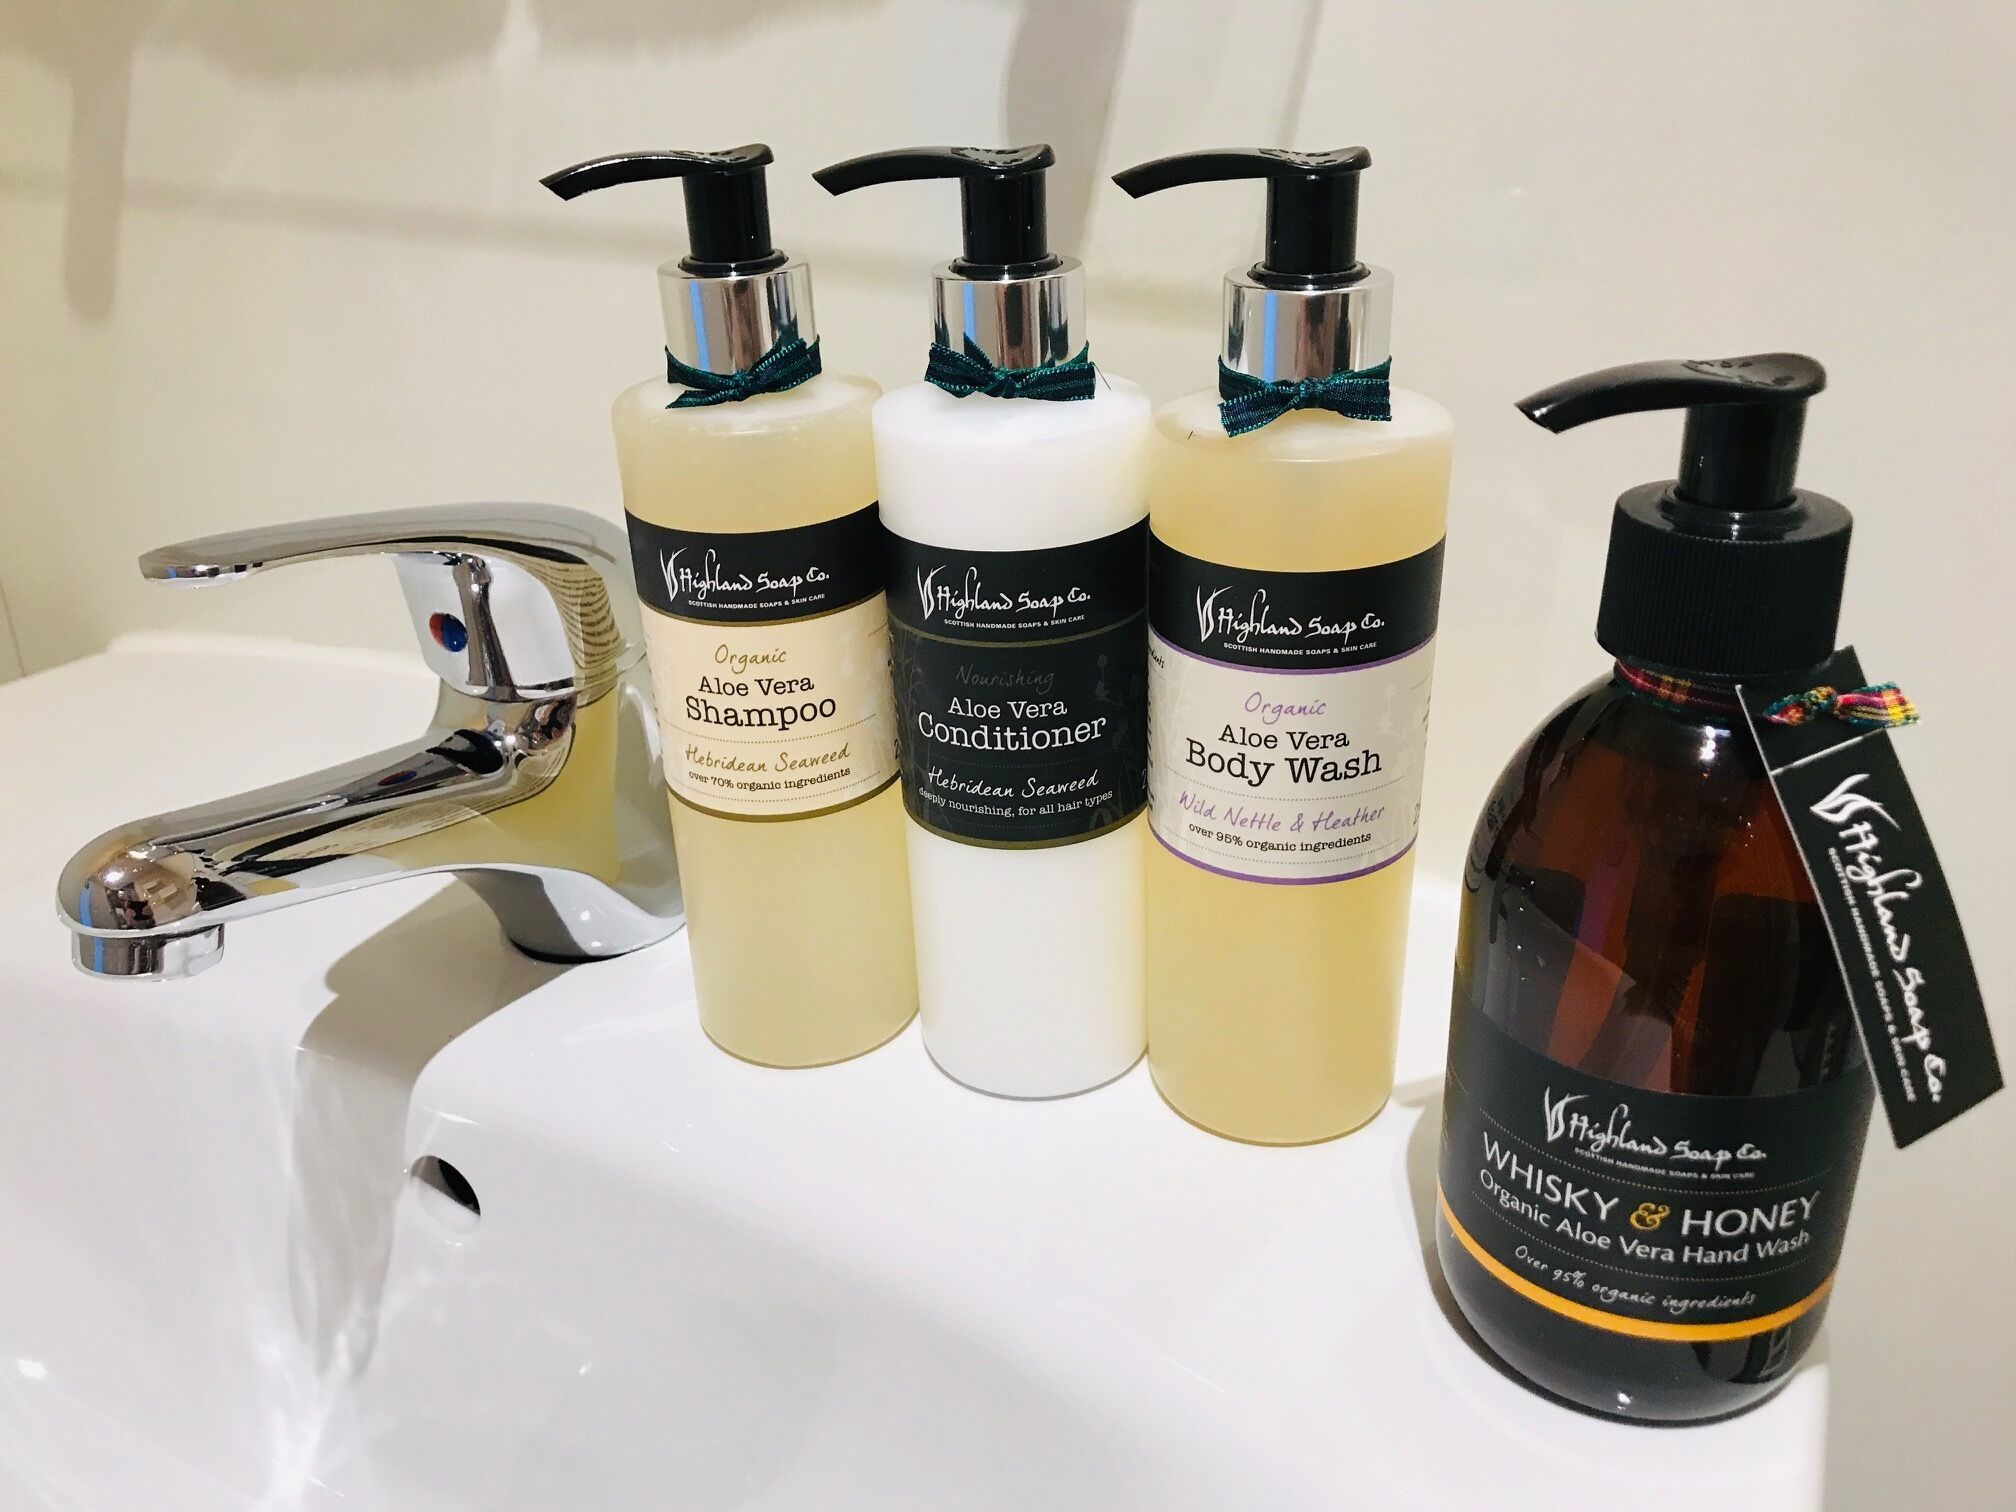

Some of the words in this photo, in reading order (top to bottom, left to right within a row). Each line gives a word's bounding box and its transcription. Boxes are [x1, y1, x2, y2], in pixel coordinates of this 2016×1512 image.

[679, 548, 753, 600] Highland
[755, 571, 804, 597] Soap
[806, 566, 830, 583] Co.
[688, 600, 718, 609] SCOTTISH
[759, 601, 783, 609] SOAPS
[791, 597, 807, 605] SKIN
[808, 593, 826, 602] CARE
[938, 566, 1013, 619] Highland
[1016, 591, 1064, 618] Soap
[1068, 586, 1090, 602] Co.
[944, 618, 974, 628] SCOTTISH
[1050, 618, 1067, 626] SKIN
[1068, 614, 1085, 624] CARE
[1218, 588, 1302, 642] Highland
[1305, 617, 1357, 644] Soap
[1361, 613, 1385, 629] Co.
[714, 644, 786, 674] Organic
[1223, 641, 1258, 653] SCOTTISH
[1260, 647, 1303, 656] HANDMADE
[1341, 645, 1358, 653] SKIN
[1360, 641, 1377, 650] CARE
[699, 676, 748, 696] Aloe
[755, 677, 814, 696] Vera
[956, 664, 1054, 694] Nourishing
[686, 695, 836, 730] Shampoo
[948, 697, 1000, 719] Aloe
[1006, 700, 1068, 719] Vera
[1244, 691, 1326, 725] Organic
[918, 712, 1106, 751] Conditioner
[1218, 724, 1278, 750] Aloe
[1286, 729, 1350, 751] Vera
[685, 744, 767, 772] Hebridean
[775, 742, 850, 772] Seaweed
[1186, 737, 1275, 787] Body
[1284, 750, 1382, 784] Wash
[689, 771, 709, 785] over
[711, 775, 734, 789] 70%
[737, 779, 781, 791] organic
[784, 767, 850, 789] ingredients
[928, 766, 1014, 797] Hebridean
[1022, 769, 1099, 798] Seaweed
[918, 787, 946, 807] deeply
[949, 800, 1015, 818] nourishing,
[1018, 805, 1036, 816] for
[1040, 804, 1054, 814] all
[1058, 799, 1083, 813] hair
[1085, 790, 1113, 808] types
[1179, 790, 1216, 821] Wild
[1223, 807, 1281, 832] Nettle
[1290, 813, 1303, 832] &
[1312, 805, 1385, 832] Heather
[1189, 821, 1214, 838] over
[1216, 830, 1243, 847] 95%
[1246, 838, 1296, 852] organic
[1300, 832, 1372, 852] ingredients
[1828, 847, 1855, 905] SCOTTISH
[1851, 907, 1880, 978] HANDMADE
[1875, 980, 1893, 1022] SOAPS
[1839, 821, 1922, 962] Highland
[1892, 967, 1931, 1051] Soap
[1924, 1053, 1947, 1103] Co.
[1569, 1103, 1667, 1155] Highland
[1670, 1139, 1732, 1171] Soap
[1736, 1143, 1767, 1160] Co.
[1483, 1131, 1620, 1221] WHISKY
[1629, 1202, 1671, 1231] &
[1681, 1190, 1821, 1236] HONEY
[1616, 1160, 1666, 1176] HANDMADE
[1480, 1168, 1551, 1227] Organic
[1555, 1217, 1612, 1249] Aloe
[1619, 1235, 1674, 1263] Vera
[1682, 1243, 1749, 1264] Hand
[1756, 1229, 1811, 1259] Wash
[1515, 1245, 1548, 1270] Over
[1552, 1269, 1587, 1288] 95%
[1591, 1283, 1656, 1303] organic
[1661, 1291, 1757, 1316] ingredients
